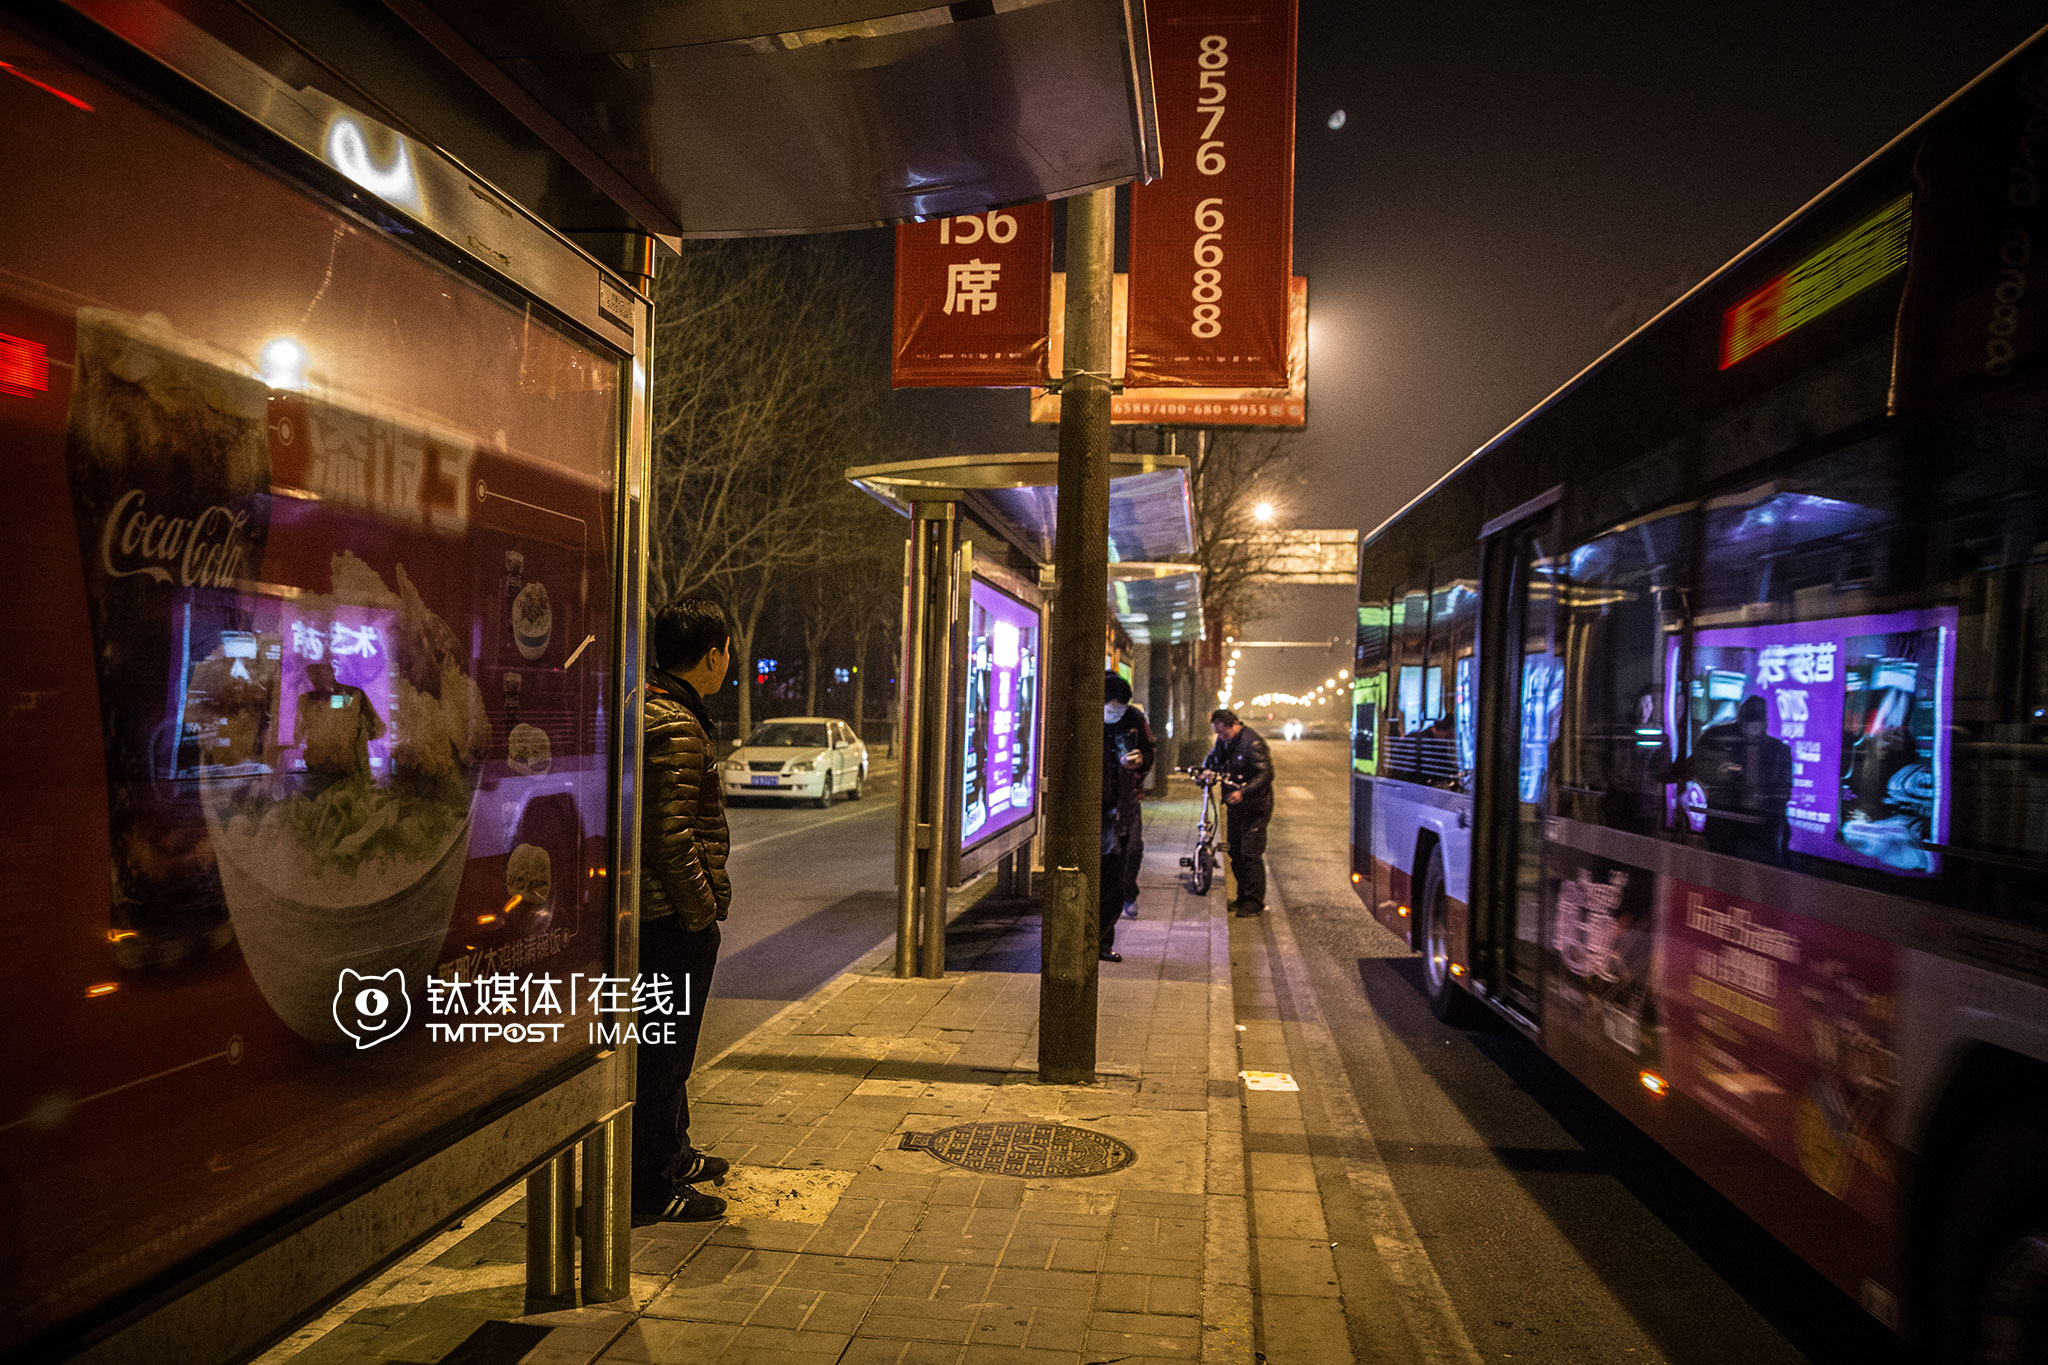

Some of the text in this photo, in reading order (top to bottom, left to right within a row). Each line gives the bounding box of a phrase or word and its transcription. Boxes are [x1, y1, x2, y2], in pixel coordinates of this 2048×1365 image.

[1190, 34, 1230, 339] 8576 6688
[940, 209, 1018, 245] 156
[942, 257, 1001, 316] 席
